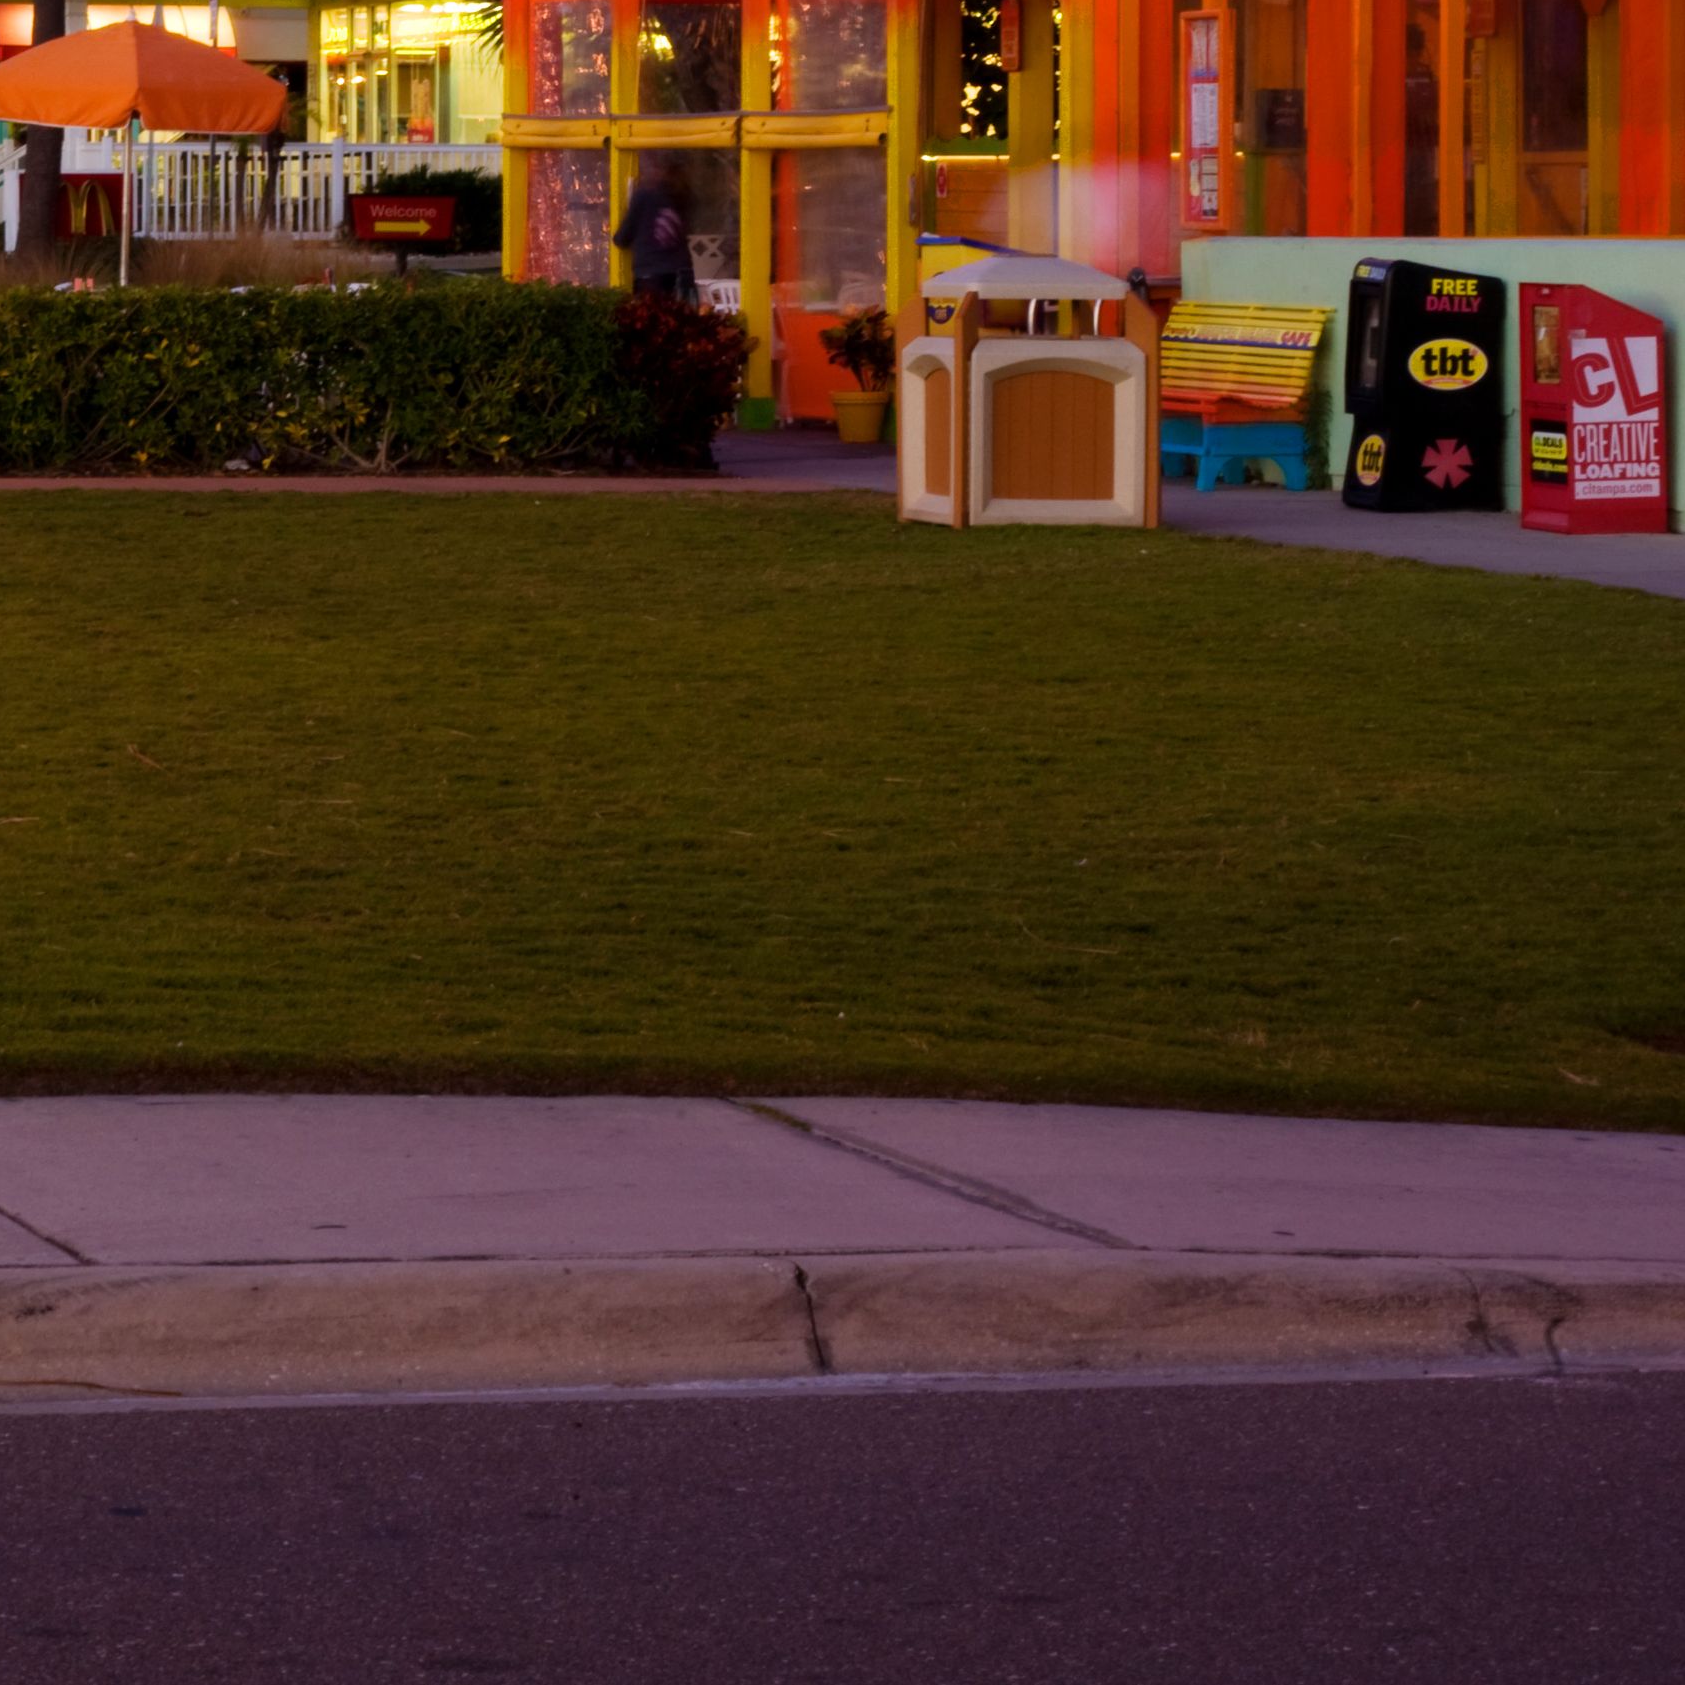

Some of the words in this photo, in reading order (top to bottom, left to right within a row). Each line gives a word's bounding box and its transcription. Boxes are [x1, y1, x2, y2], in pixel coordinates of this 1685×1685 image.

[370, 204, 437, 218] Welcome
[1431, 278, 1479, 296] FREE
[1426, 296, 1482, 313] DAILY
[1421, 347, 1476, 377] tbt
[1571, 337, 1661, 417] CL
[1573, 422, 1660, 463] CREATIVE
[1362, 443, 1382, 473] tbt
[1574, 463, 1661, 479] LOAFING
